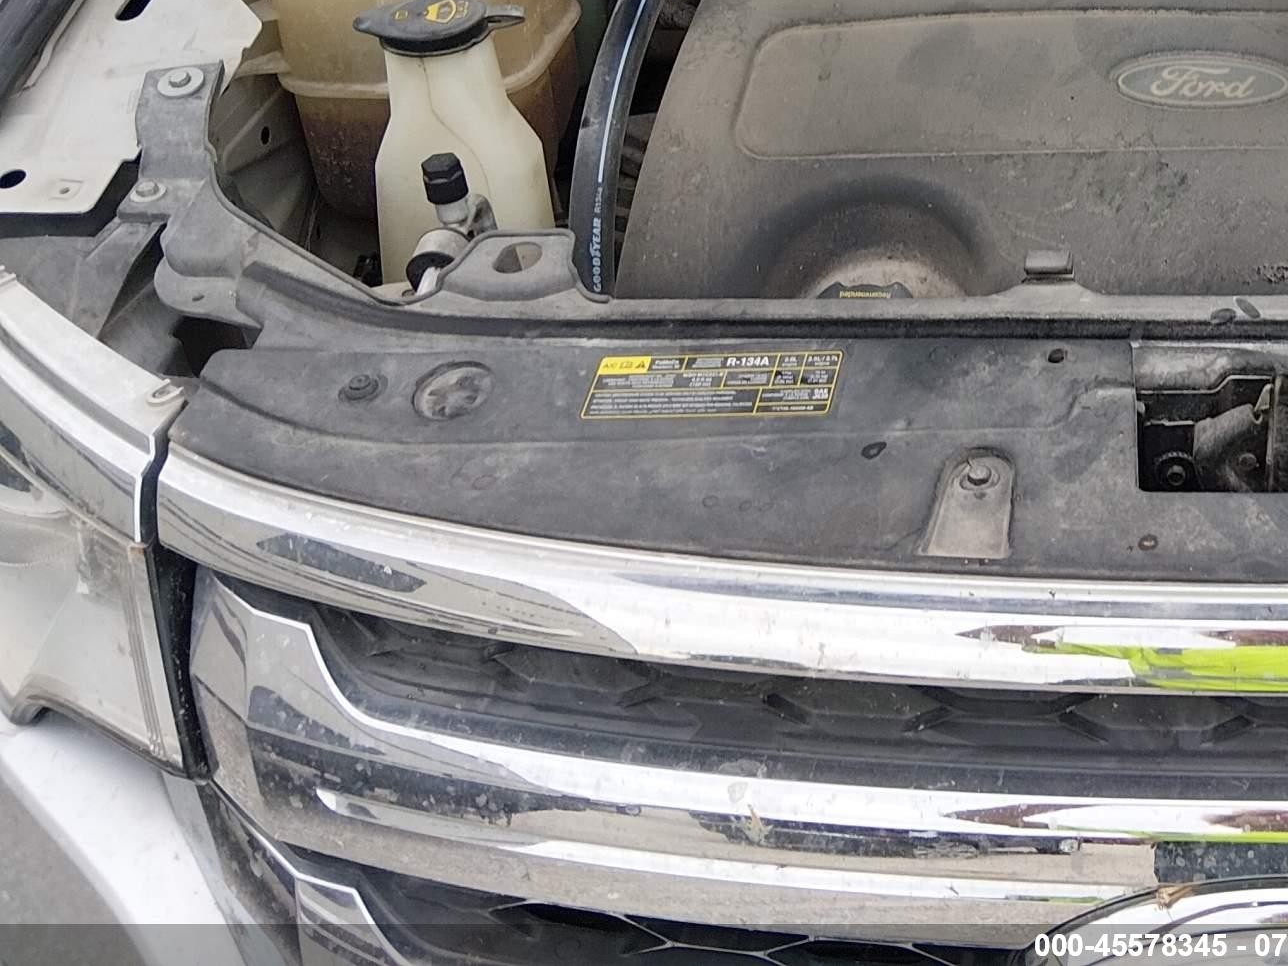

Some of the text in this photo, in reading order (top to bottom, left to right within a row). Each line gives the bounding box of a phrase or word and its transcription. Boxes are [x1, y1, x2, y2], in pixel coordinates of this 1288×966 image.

[1151, 65, 1256, 99] Ford
[590, 217, 602, 292] GOODYEAR
[726, 356, 770, 367] R-134A
